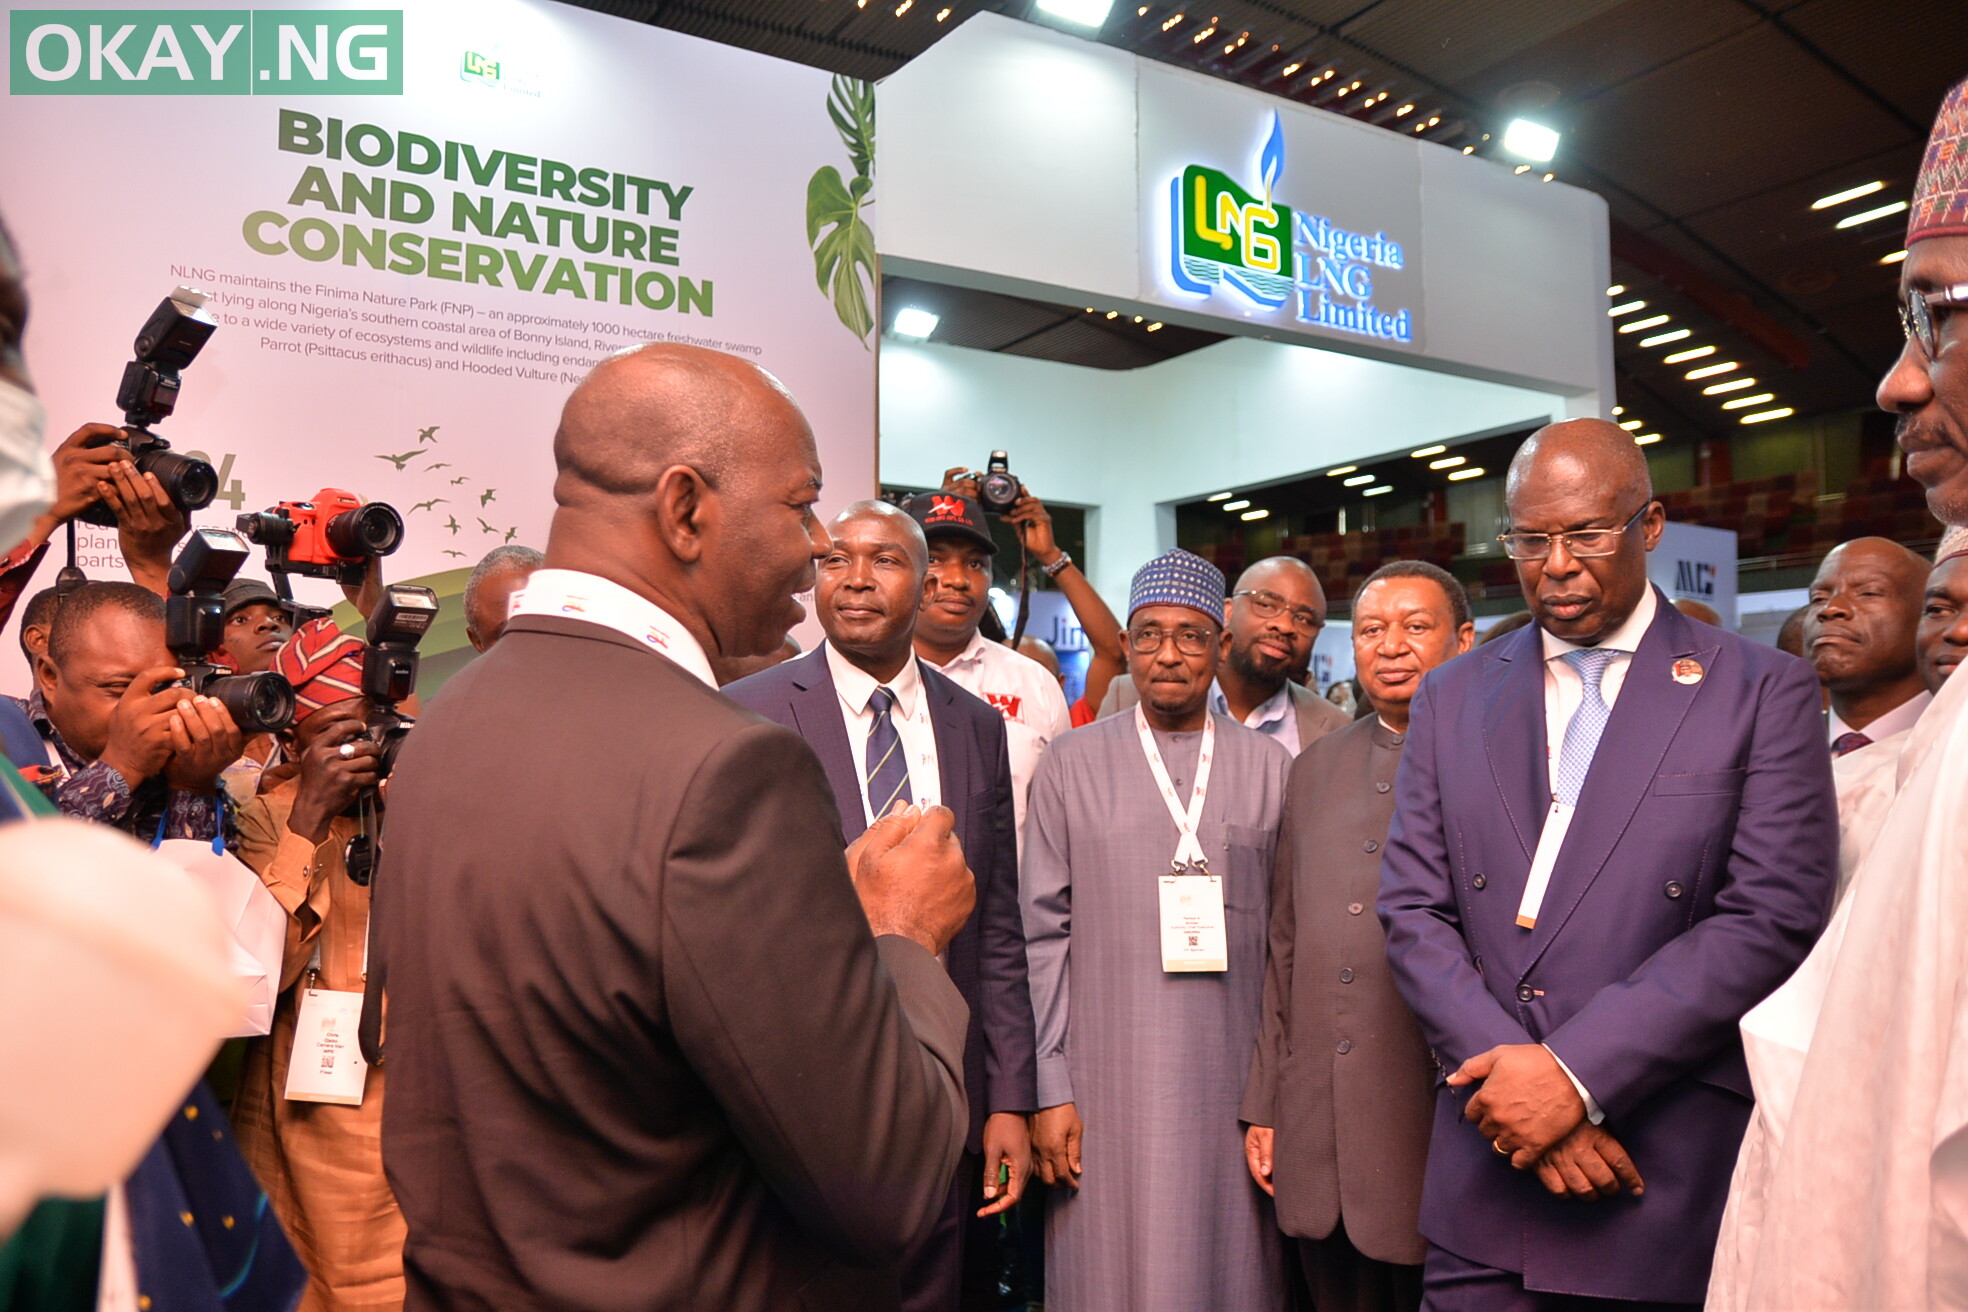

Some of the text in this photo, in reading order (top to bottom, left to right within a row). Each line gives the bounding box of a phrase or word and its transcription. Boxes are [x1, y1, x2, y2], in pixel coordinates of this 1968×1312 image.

[278, 108, 694, 221] BIODIVERSITY
[287, 165, 680, 267] AND NATURE
[1293, 211, 1405, 270] Nigeria
[242, 210, 714, 318] CONSERVATION
[1293, 252, 1373, 300] LNG
[170, 264, 216, 281] NLNG
[219, 274, 286, 292] maintains
[290, 281, 312, 295] the
[315, 284, 359, 301] Finima
[363, 291, 407, 307] Nature
[410, 297, 438, 312] Park
[440, 301, 474, 318] (FNP)
[489, 309, 504, 320] an
[507, 312, 589, 333] approximately
[592, 321, 620, 336] 1000
[623, 325, 664, 341] hectare
[667, 332, 722, 348] freshwater
[725, 341, 762, 356] swamp
[222, 292, 254, 310] lying
[258, 297, 297, 316] along
[301, 303, 358, 322] Nigeria's
[362, 310, 418, 328] southern
[422, 318, 466, 334] coastal
[469, 327, 496, 339] area
[499, 328, 513, 340] of
[514, 330, 552, 349] Bonny
[555, 335, 592, 351] Island,
[1296, 288, 1413, 343] Limited
[224, 313, 238, 325] to
[241, 317, 250, 327] a
[254, 317, 288, 331] wide
[290, 322, 336, 340] variety
[339, 327, 353, 340] of
[355, 331, 431, 351] ecosystems
[434, 338, 459, 352] and
[461, 341, 504, 358] wildlife
[507, 347, 560, 368] including
[562, 356, 601, 368] endan
[260, 337, 302, 353] Parrot
[305, 342, 367, 361] (Psittacus
[370, 350, 432, 370] erithacus)
[435, 357, 459, 372] and
[462, 360, 513, 377] Hooded
[516, 366, 557, 382] Vulture
[77, 554, 124, 568] parts
